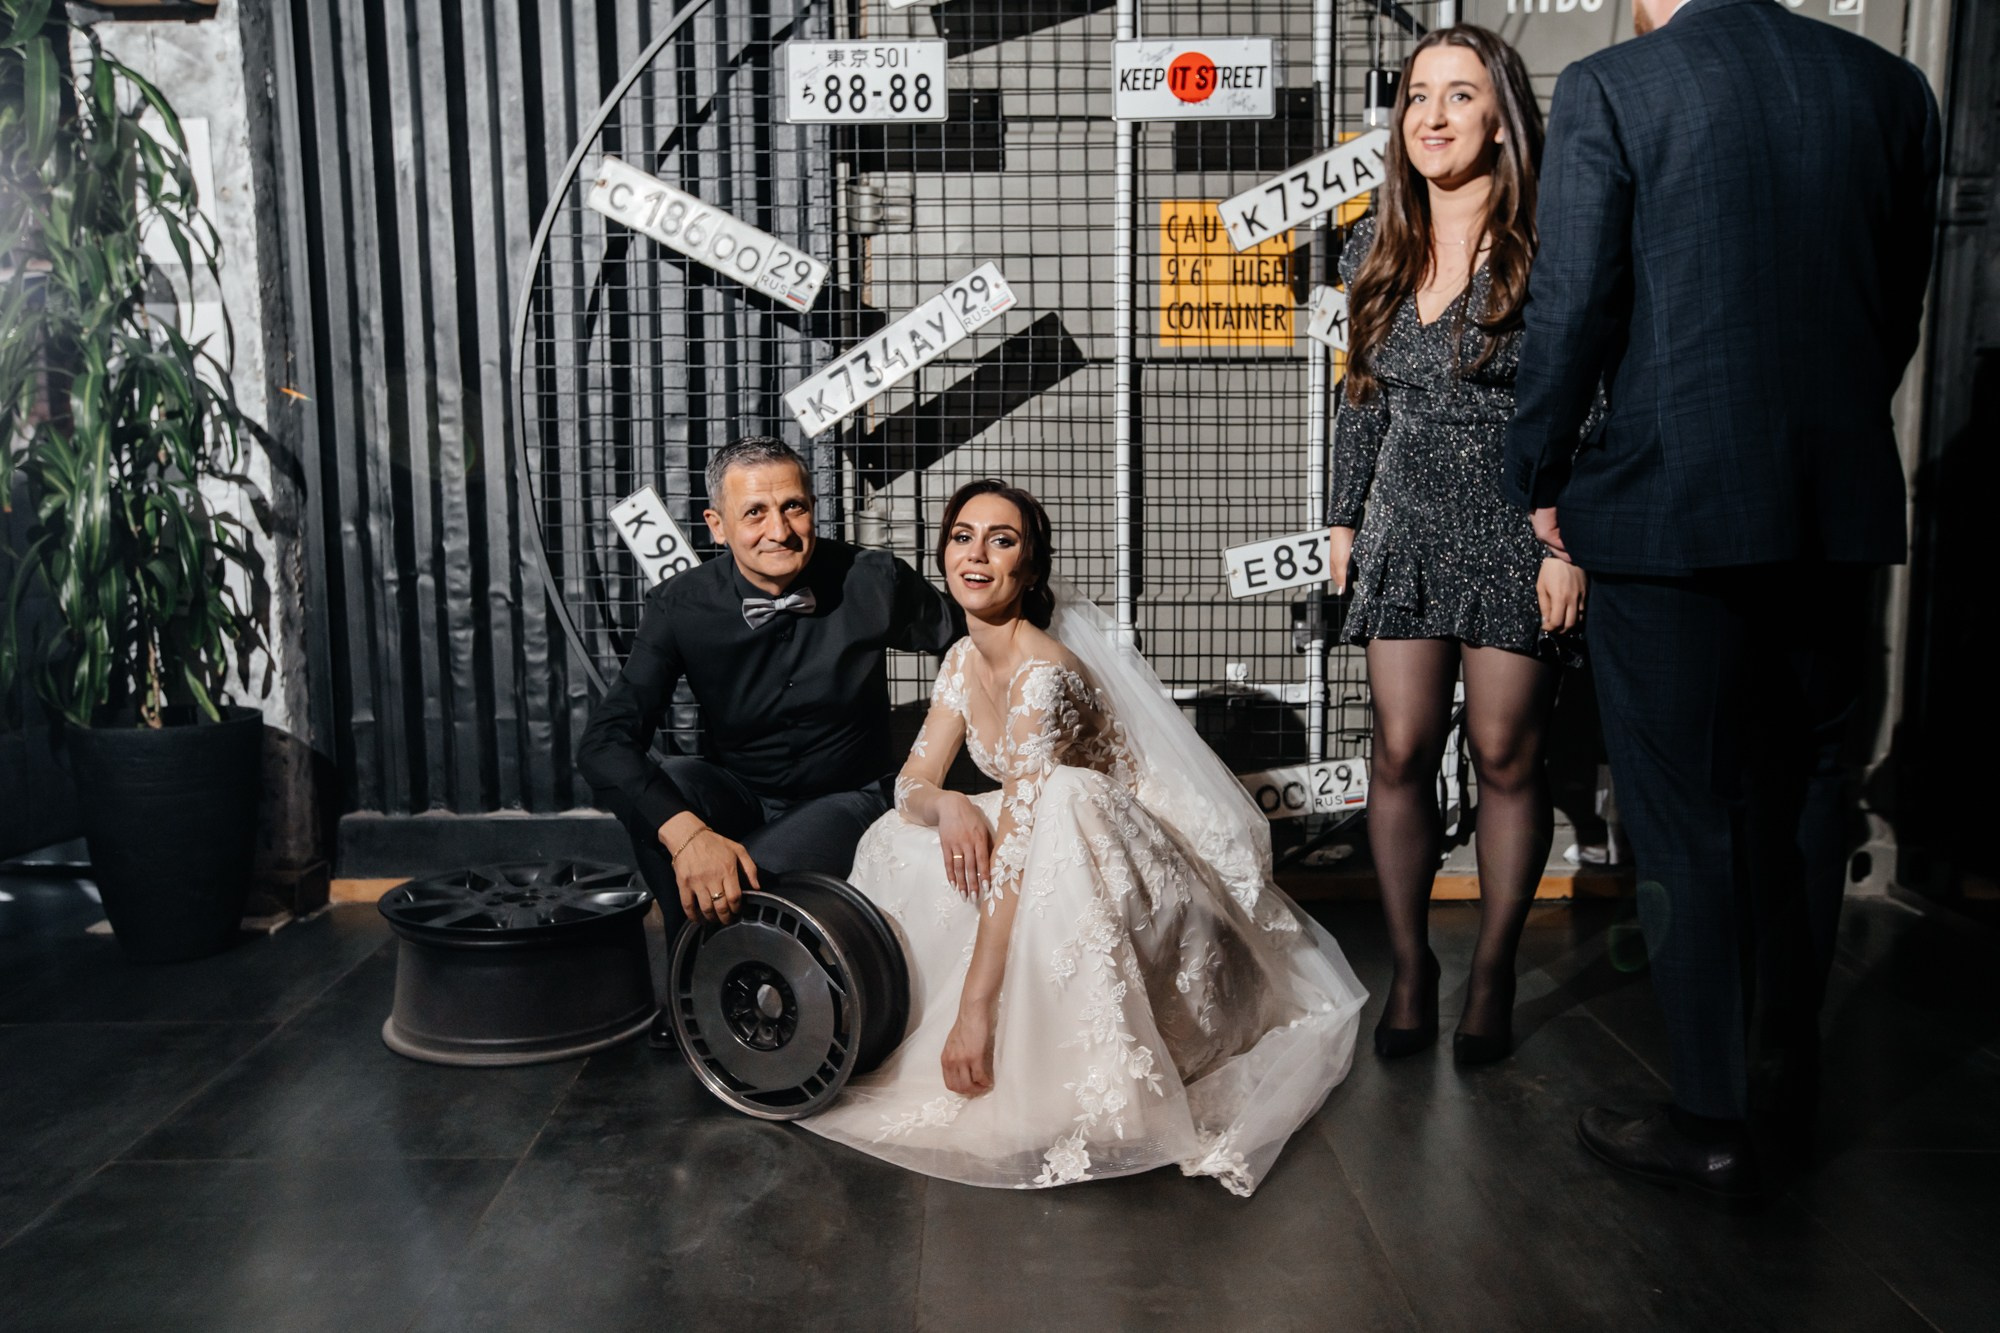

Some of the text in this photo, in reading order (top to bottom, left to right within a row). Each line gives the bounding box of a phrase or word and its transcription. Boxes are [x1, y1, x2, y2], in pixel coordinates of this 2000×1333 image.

[1120, 65, 1267, 91] KEEP IT STREET
[824, 73, 932, 113] 88-88
[769, 251, 812, 286] 29
[1232, 259, 1287, 287] HIGH
[761, 274, 787, 295] RUS
[952, 275, 991, 316] 29
[963, 305, 992, 329] RUS
[1167, 302, 1287, 331] CONTAINER
[1315, 764, 1353, 796] 29
[1315, 795, 1343, 808] RUS
